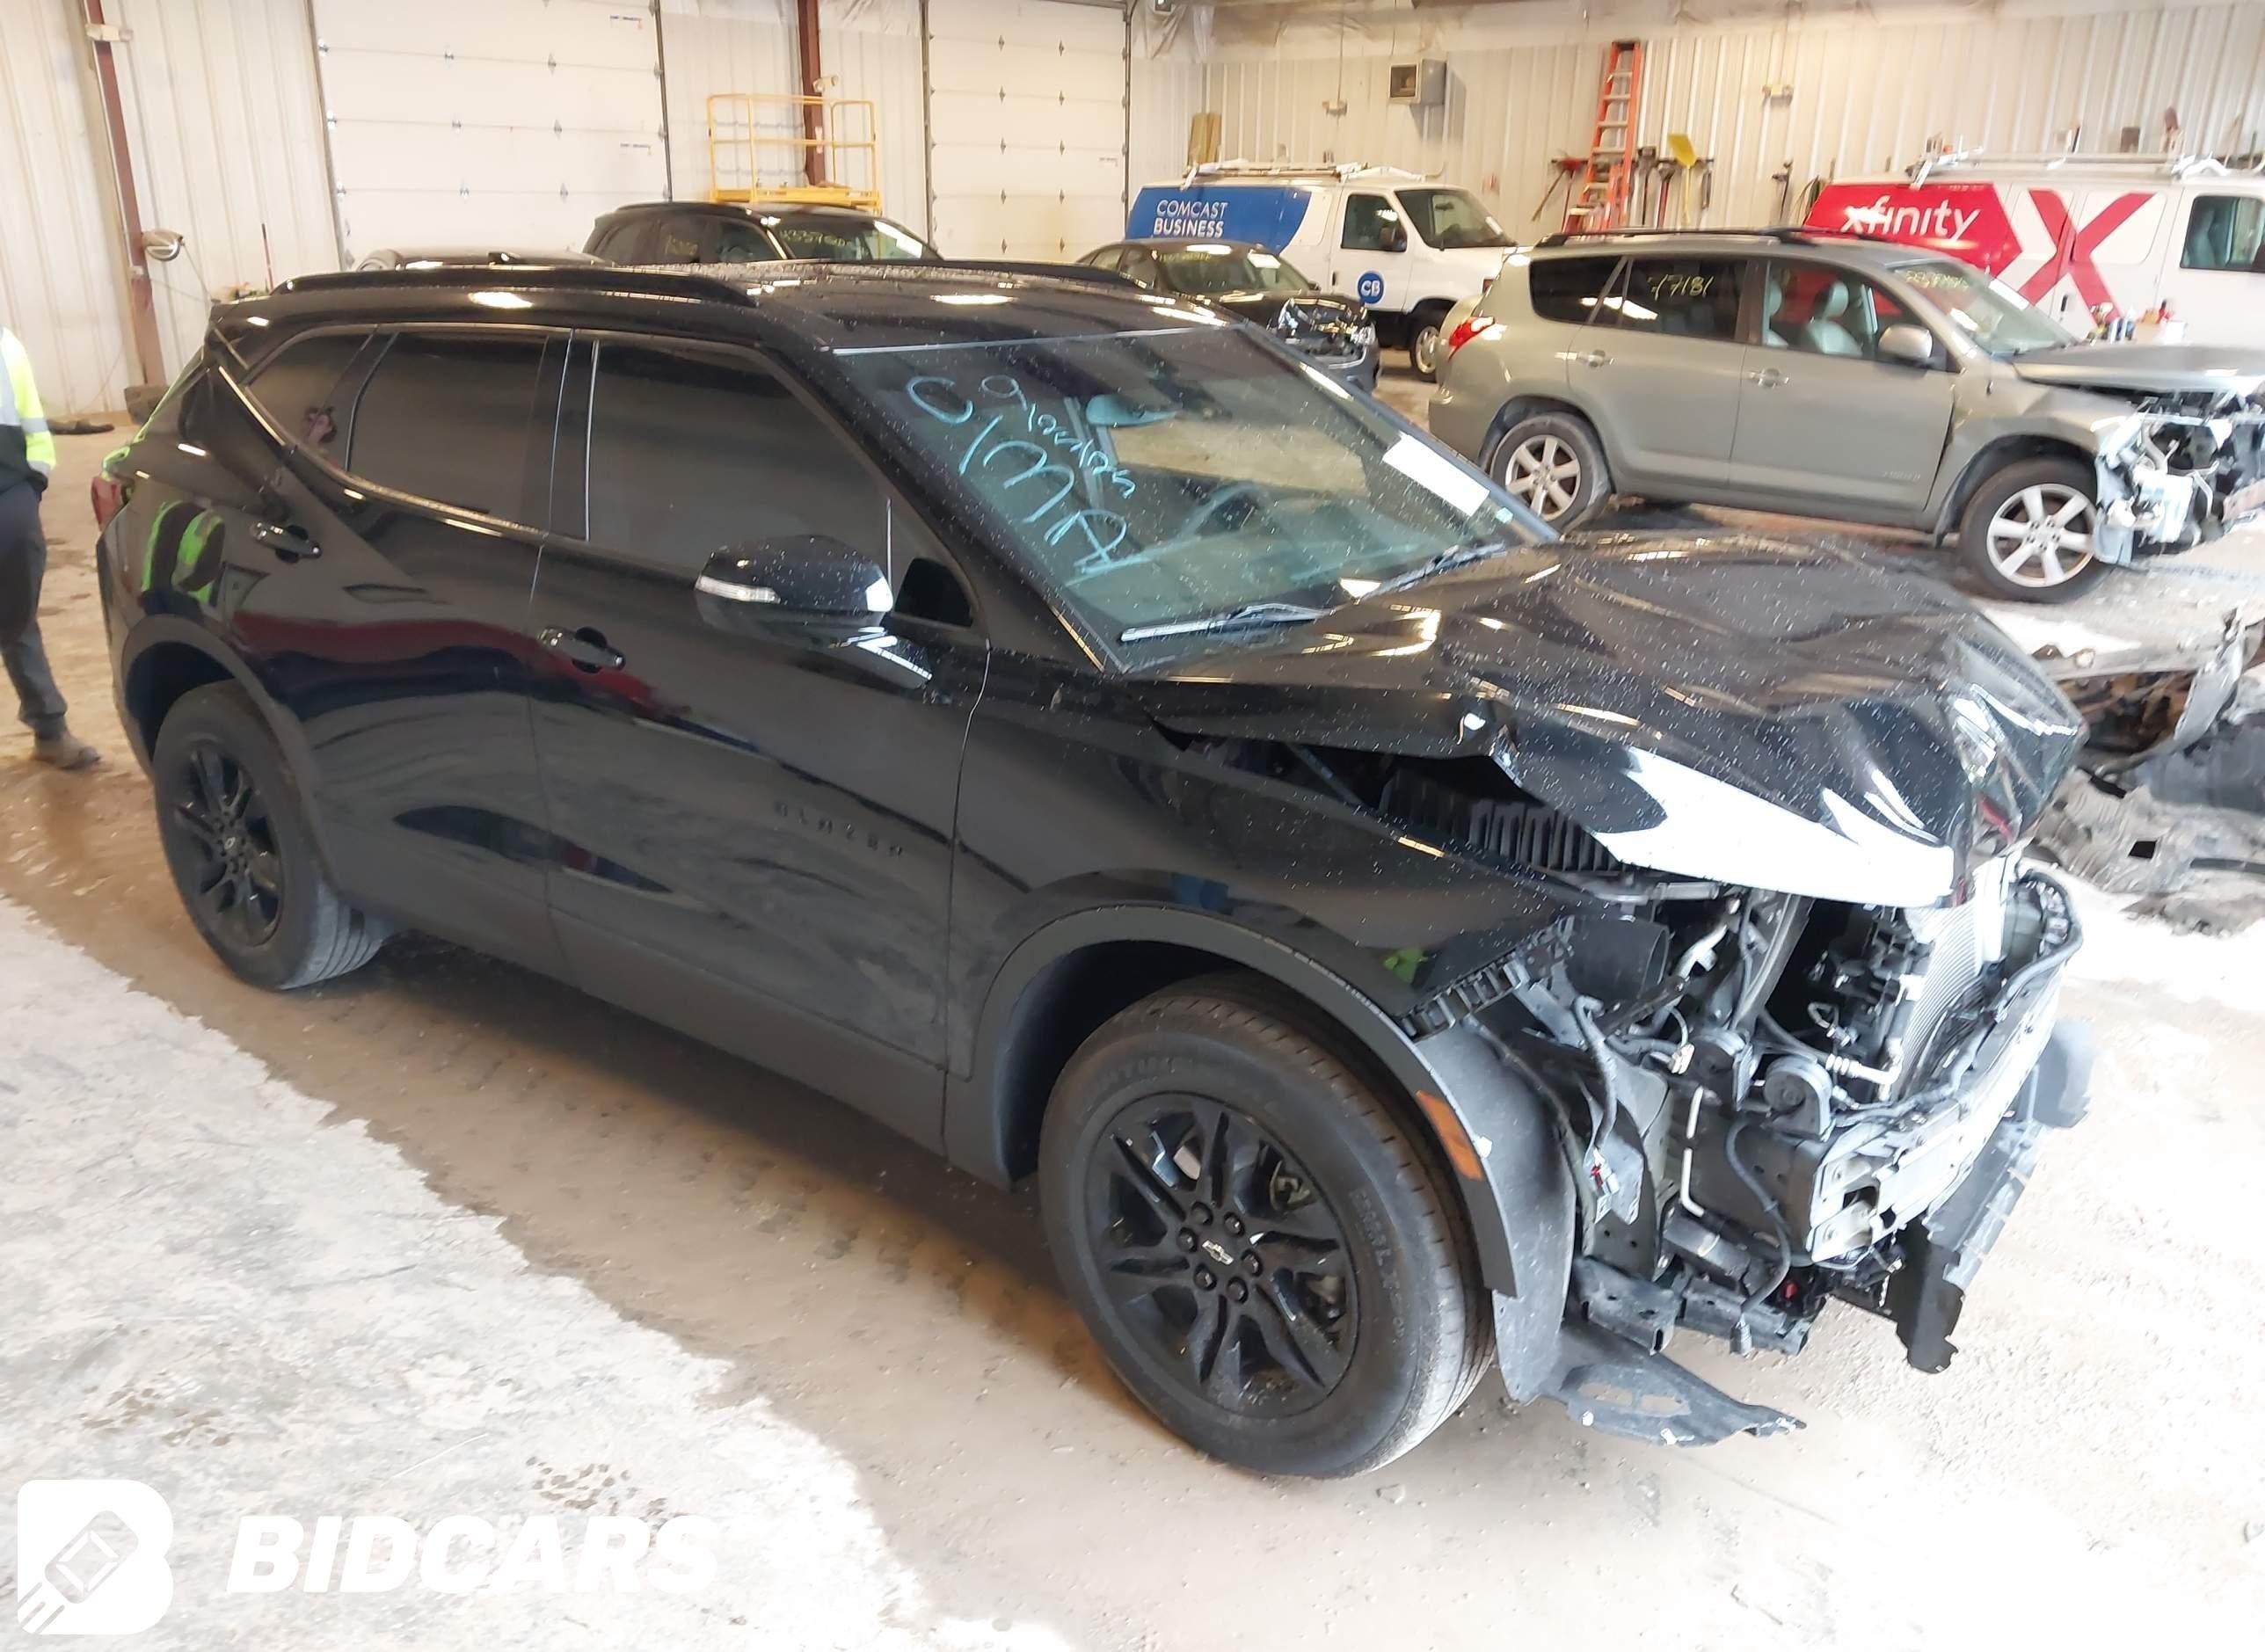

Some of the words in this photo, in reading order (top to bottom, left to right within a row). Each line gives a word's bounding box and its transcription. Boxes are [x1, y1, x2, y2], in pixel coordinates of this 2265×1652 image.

[1156, 199, 1228, 219] COMCAST
[1840, 194, 1981, 242] xfinity
[1153, 217, 1225, 238] BUSINESS
[1360, 280, 1380, 297] CB
